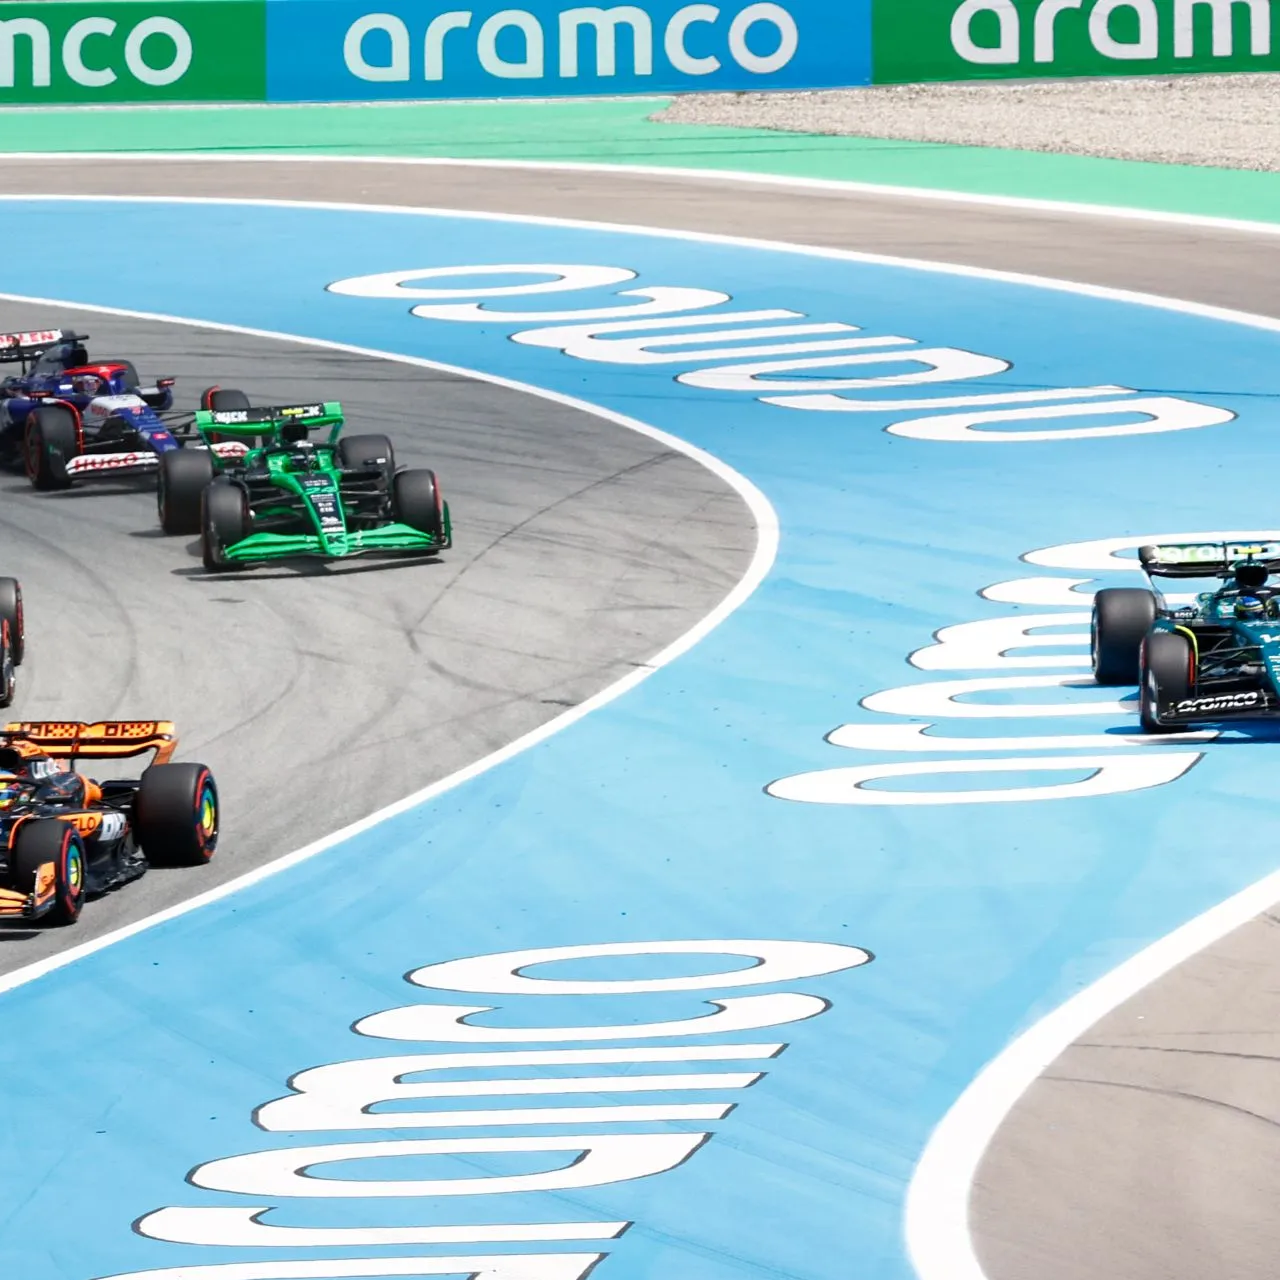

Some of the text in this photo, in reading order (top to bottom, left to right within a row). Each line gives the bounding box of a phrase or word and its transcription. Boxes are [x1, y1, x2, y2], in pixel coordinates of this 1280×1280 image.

[344, 3, 797, 81] aramco
[951, 0, 1280, 63] aram
[325, 263, 1237, 442] aramco
[74, 454, 138, 471] HUGO
[1177, 692, 1259, 713] aramco
[69, 816, 97, 831] ELO
